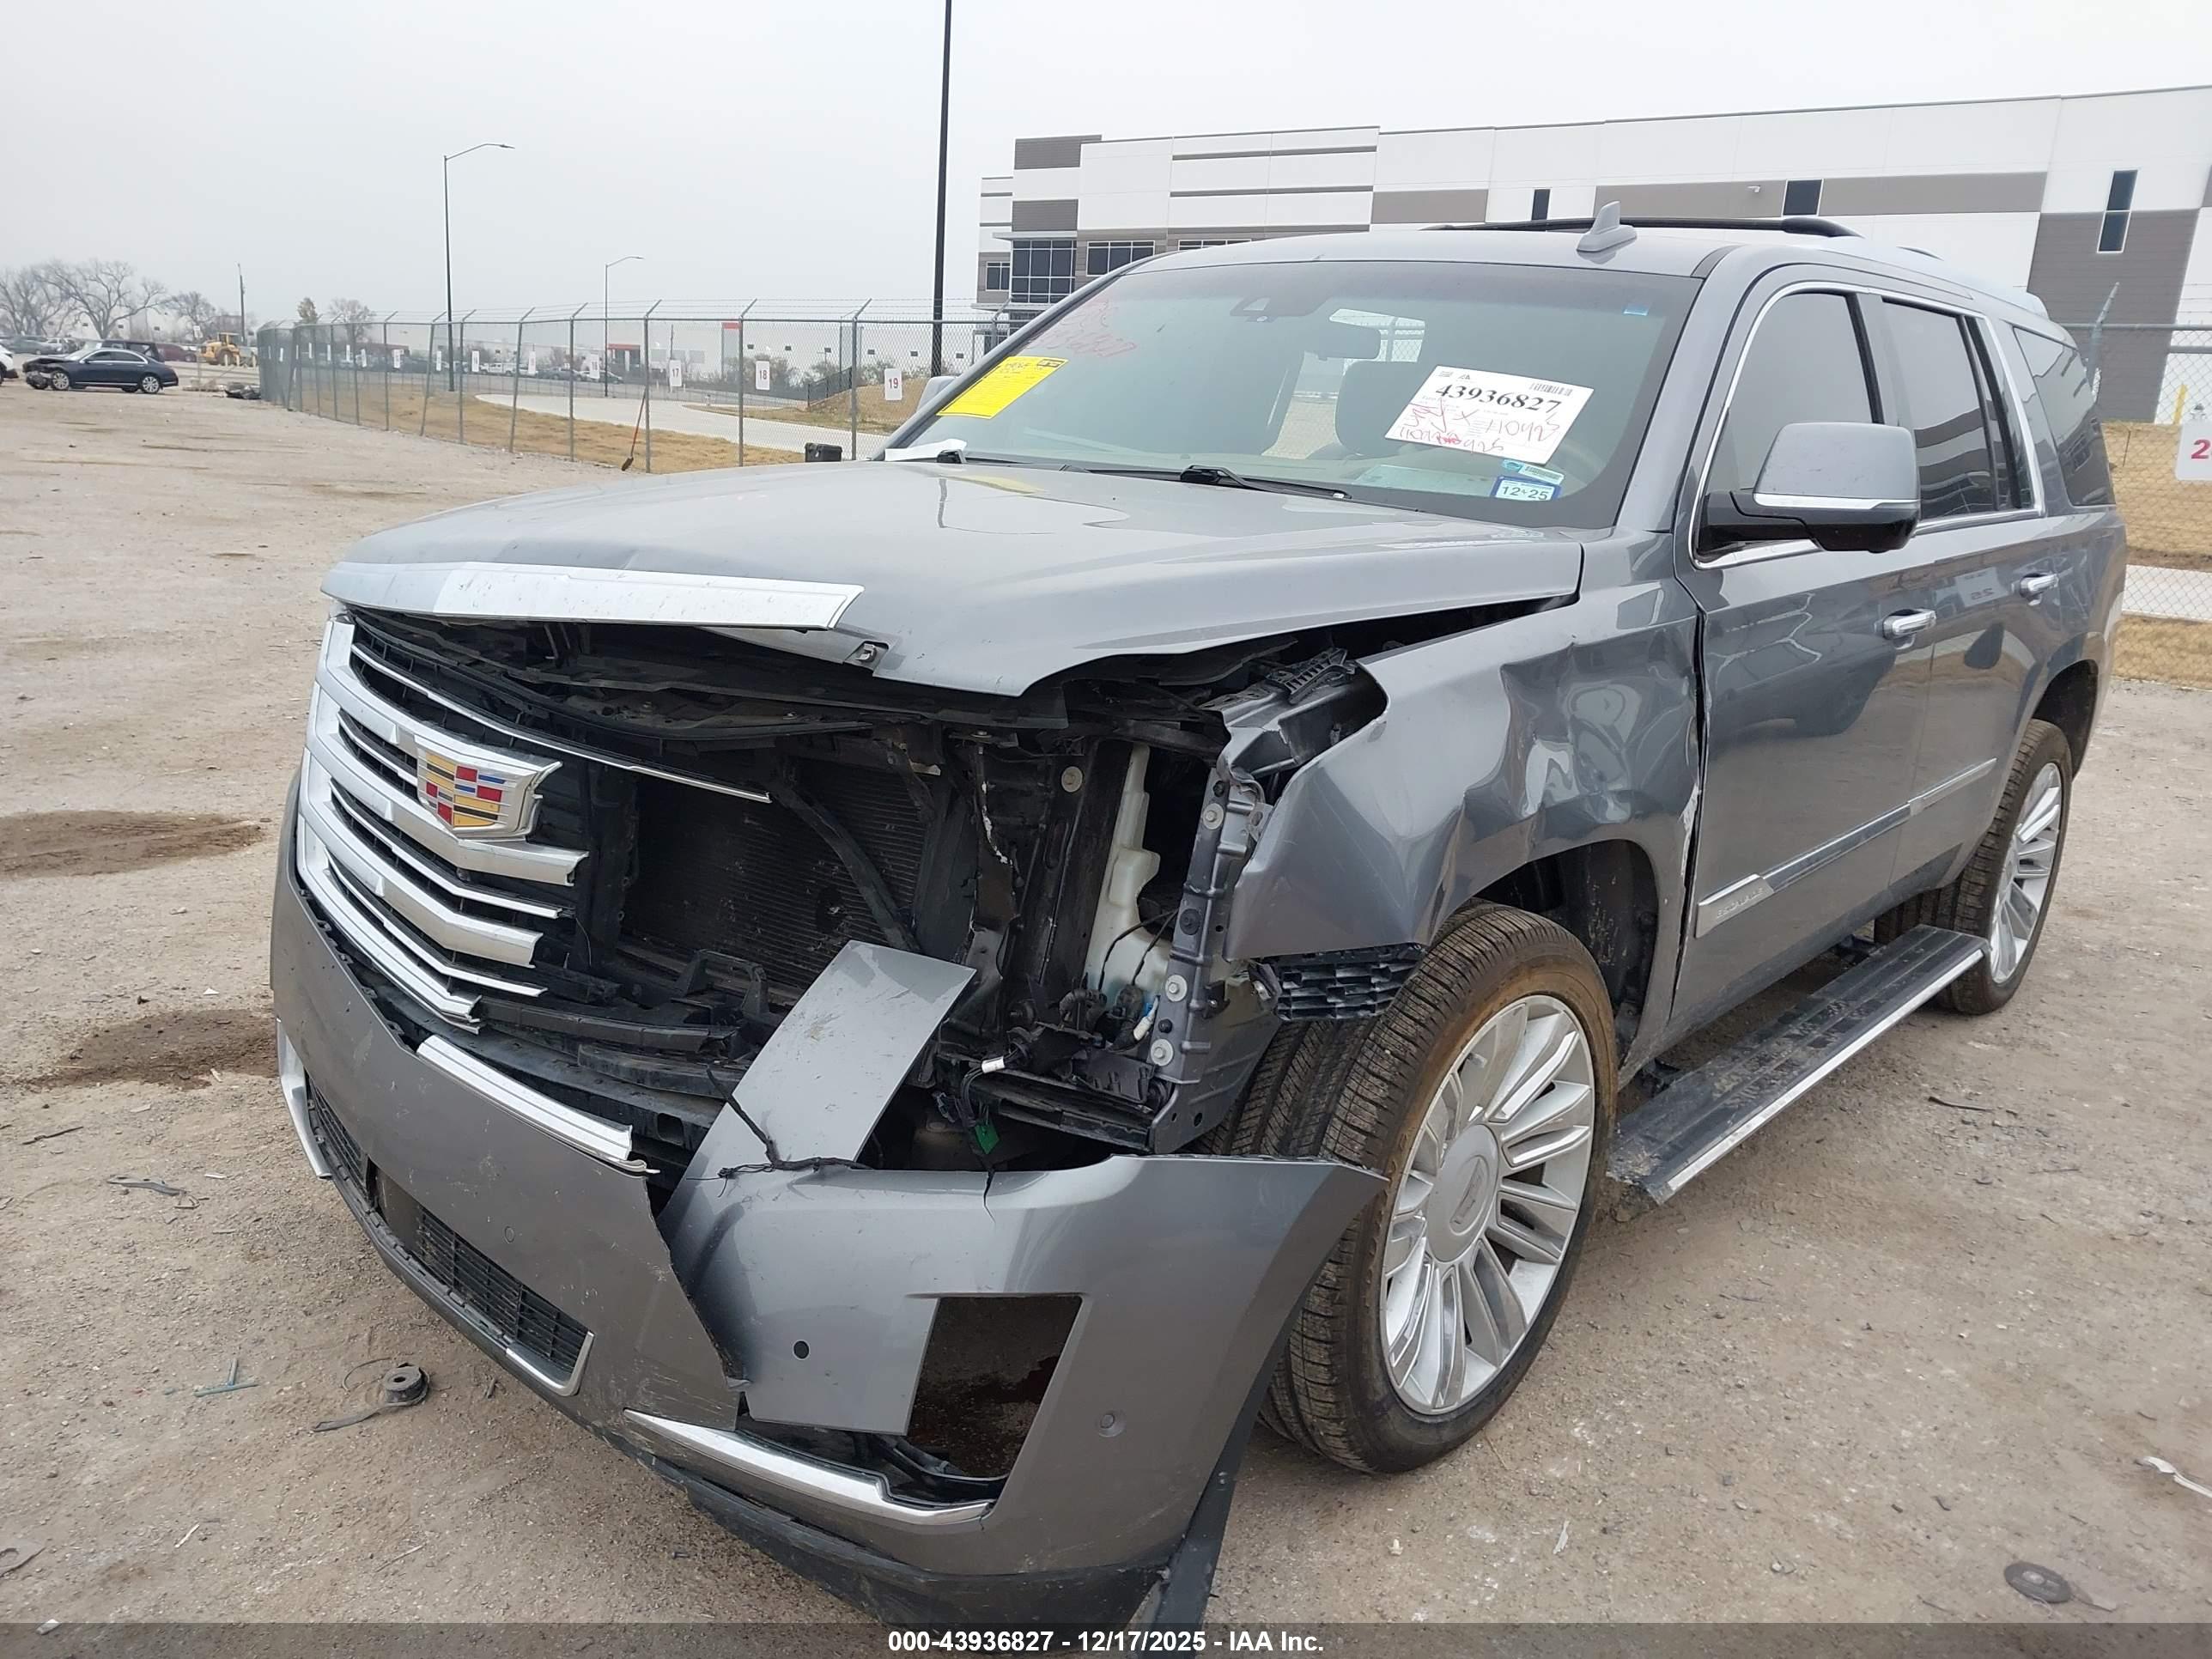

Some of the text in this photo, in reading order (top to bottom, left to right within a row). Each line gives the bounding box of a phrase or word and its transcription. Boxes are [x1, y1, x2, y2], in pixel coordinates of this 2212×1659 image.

[672, 368, 679, 379] 17
[759, 369, 768, 380] 18
[888, 377, 899, 389] 19
[1435, 383, 1562, 414] 43936827
[2191, 439, 2212, 459] 2
[1528, 489, 1549, 501] 25
